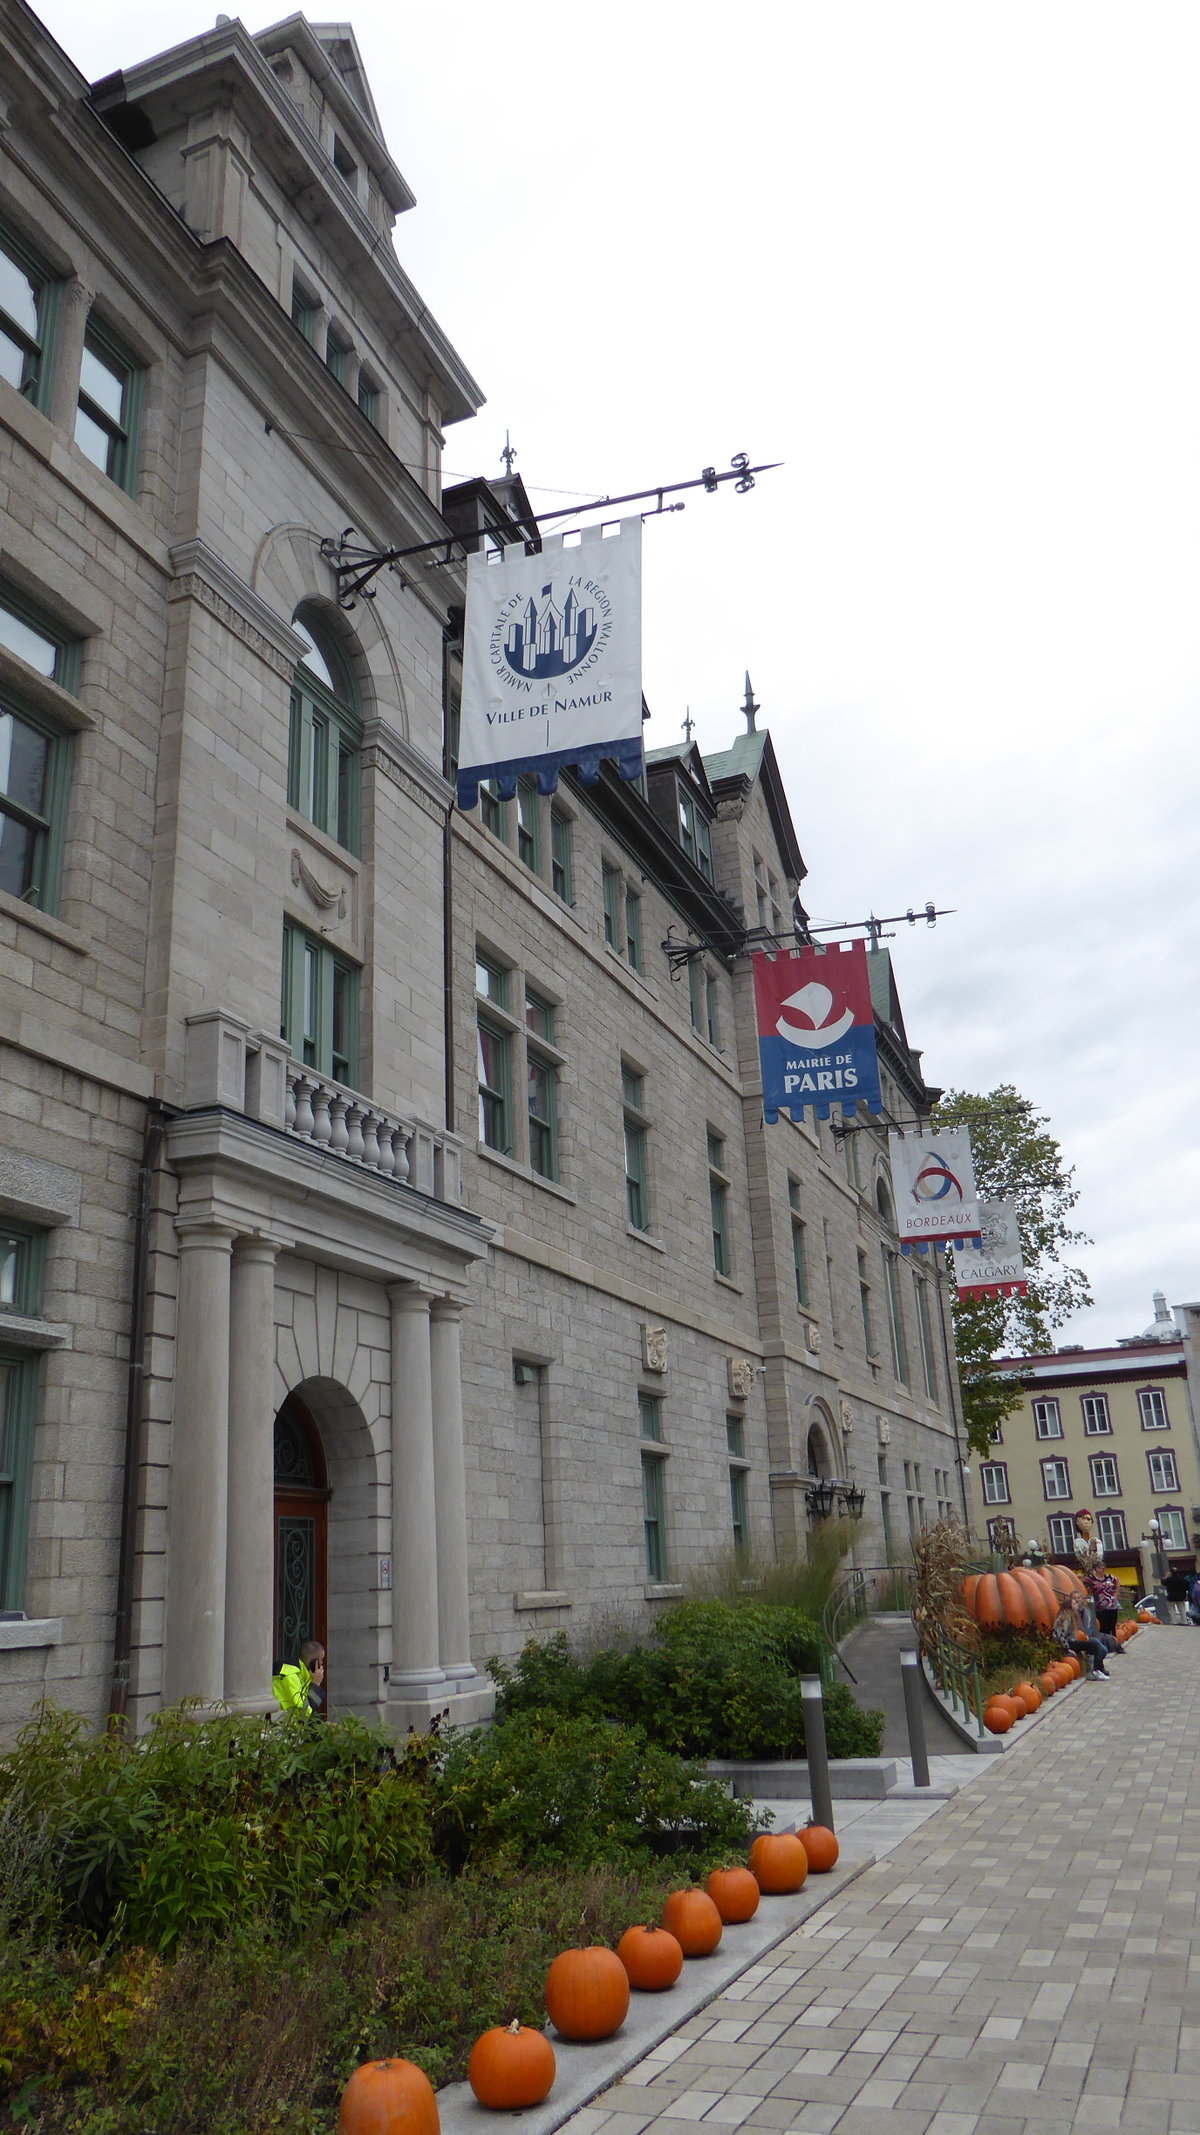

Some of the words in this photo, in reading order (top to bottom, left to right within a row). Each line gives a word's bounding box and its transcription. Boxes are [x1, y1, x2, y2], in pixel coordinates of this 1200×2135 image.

[568, 575, 582, 588] LA
[508, 592, 524, 609] DE
[489, 609, 511, 665] CAPITALE
[566, 621, 613, 686] WALLONNE
[496, 664, 533, 693] NAMUR
[486, 708, 525, 726] VILLE
[530, 703, 548, 717] DE
[554, 691, 613, 714] NAMUR
[786, 1056, 832, 1070] MAIRIE
[835, 1054, 852, 1065] DE
[784, 1068, 858, 1094] PARIS
[906, 1213, 972, 1229] BORDEAUX
[961, 1264, 1018, 1280] CALGARY
